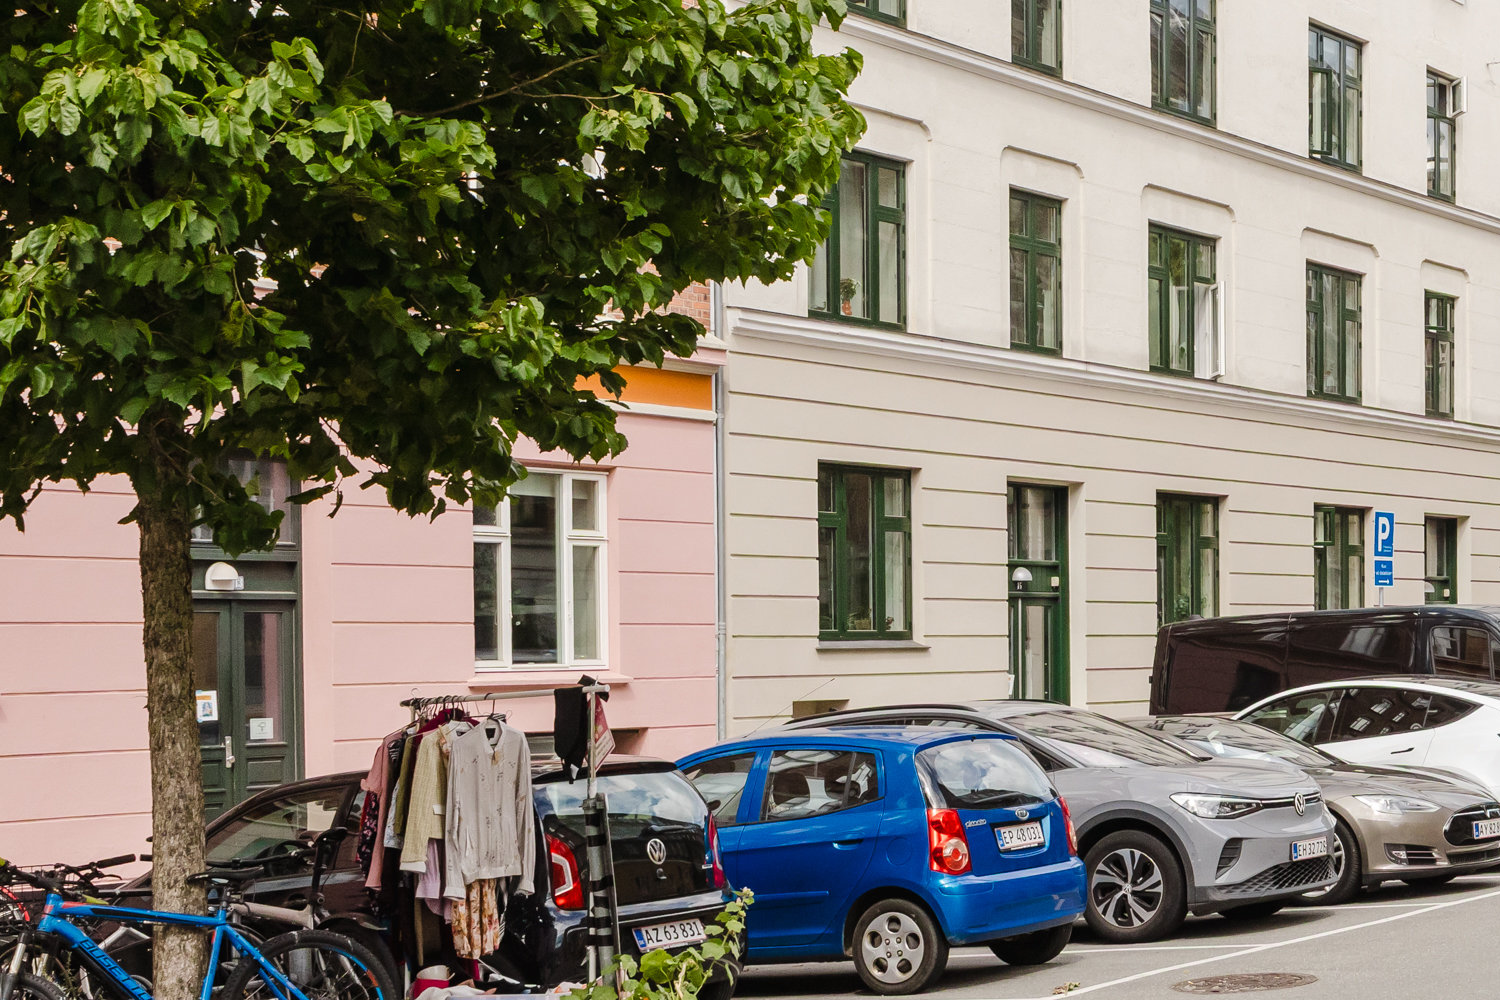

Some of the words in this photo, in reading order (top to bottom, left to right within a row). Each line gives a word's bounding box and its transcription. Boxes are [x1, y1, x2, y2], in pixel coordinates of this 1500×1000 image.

[1378, 516, 1390, 552] P
[1003, 828, 1014, 845] EP
[1016, 827, 1027, 842] 48
[1028, 826, 1042, 841] 031
[645, 928, 662, 944] AZ
[663, 925, 679, 941] 63
[680, 921, 701, 938] 831
